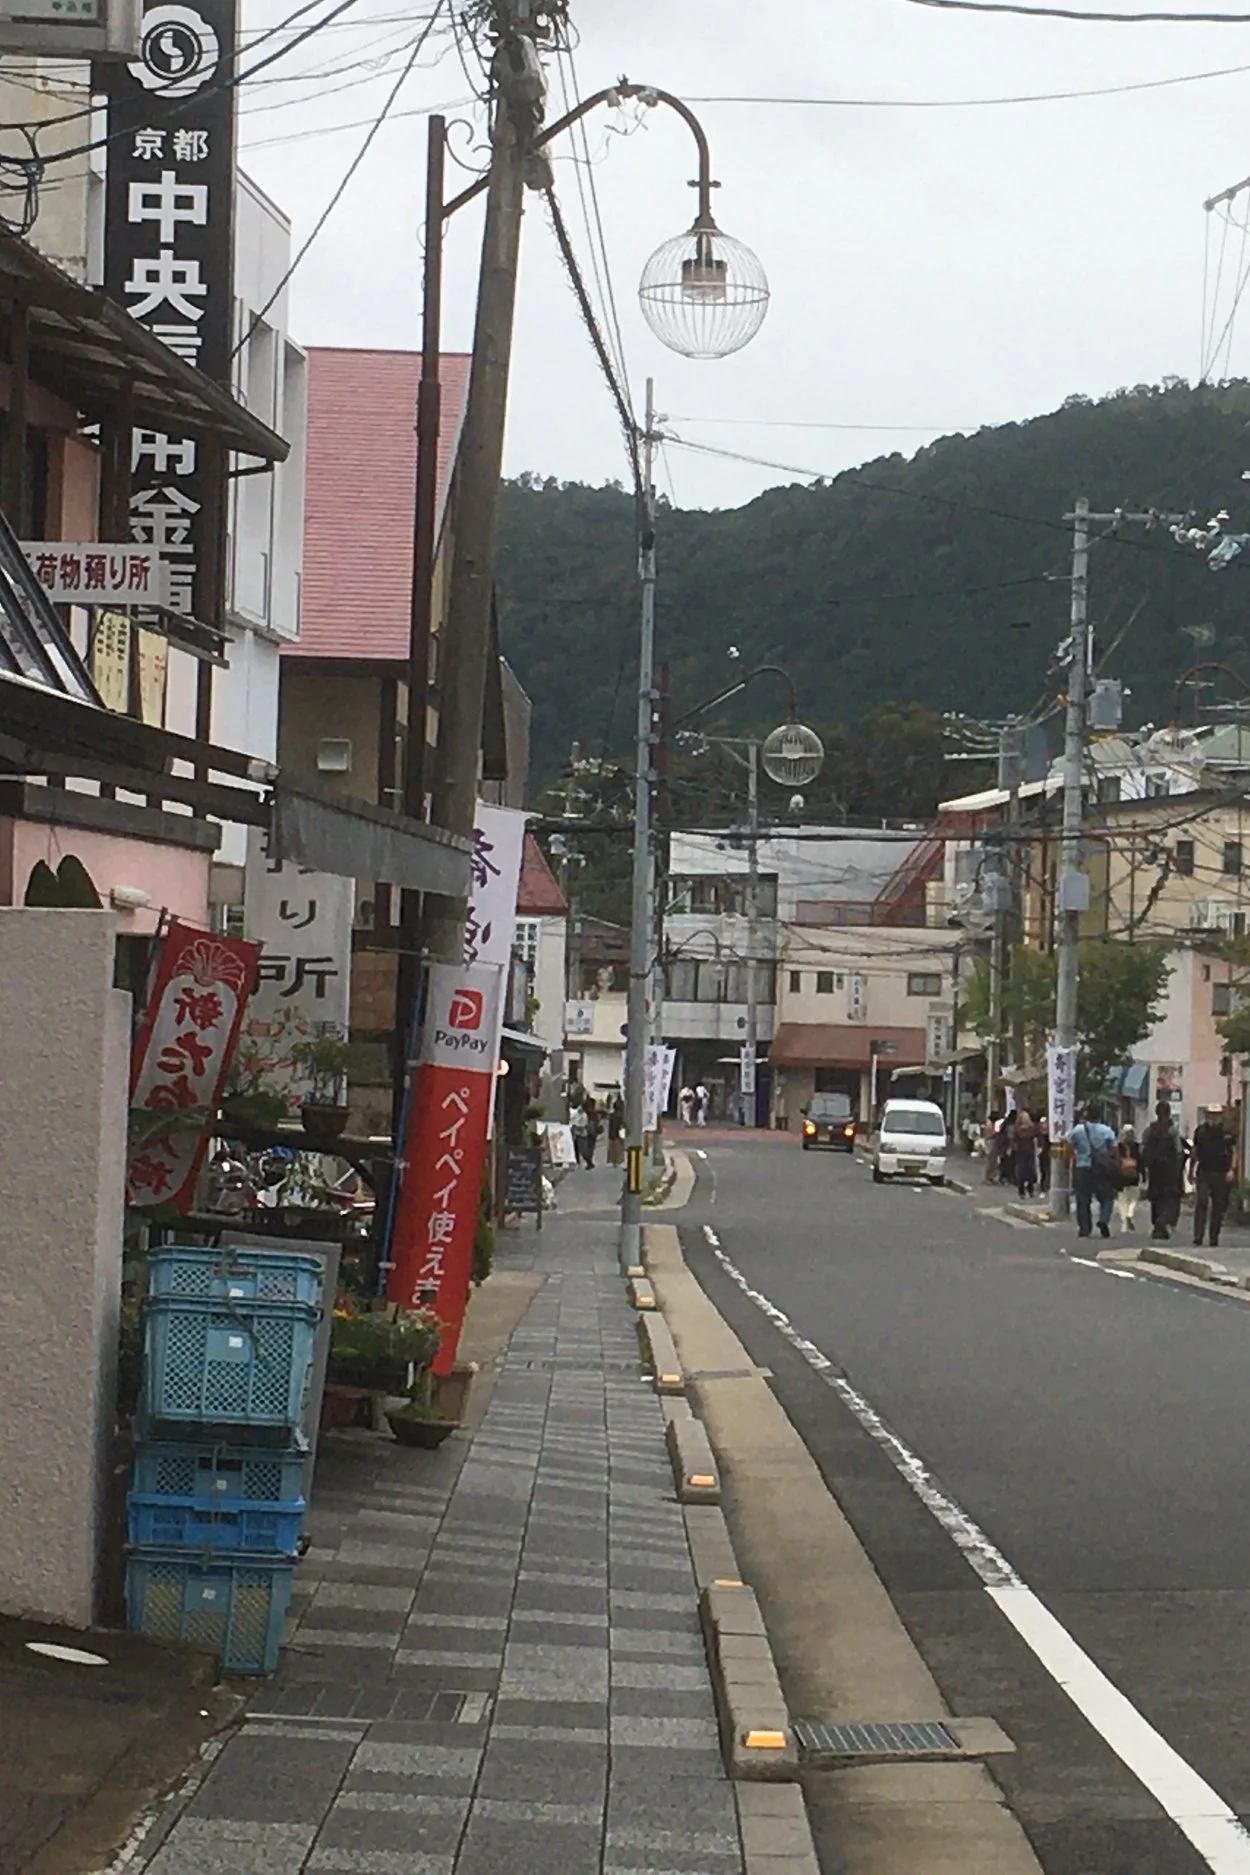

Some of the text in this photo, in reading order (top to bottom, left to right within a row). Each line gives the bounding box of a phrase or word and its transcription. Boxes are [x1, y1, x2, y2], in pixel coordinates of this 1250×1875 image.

[132, 127, 208, 162] 京都
[25, 552, 152, 592] 荷物預り所
[434, 1029, 488, 1054] PayPay
